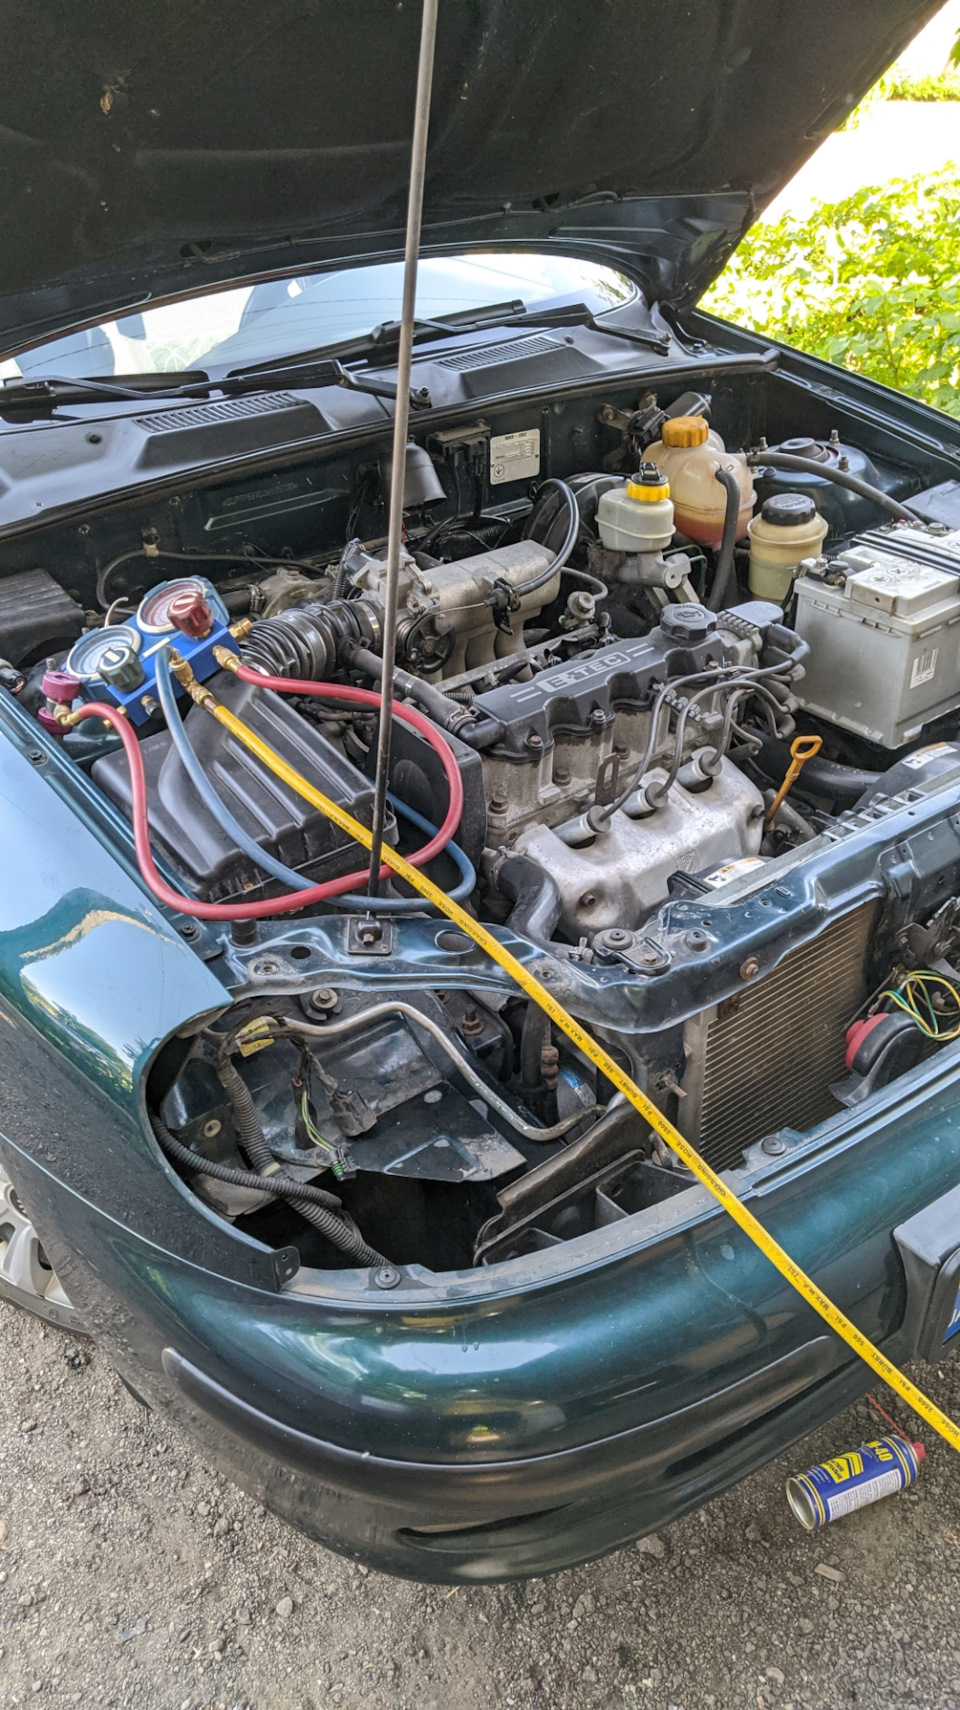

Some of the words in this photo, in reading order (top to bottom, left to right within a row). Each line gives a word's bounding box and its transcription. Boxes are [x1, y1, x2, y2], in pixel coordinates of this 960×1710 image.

[458, 918, 487, 945] CHARGING
[587, 1046, 598, 1057] PSI
[618, 1078, 637, 1098] BURST
[642, 1103, 652, 1114] PSI
[657, 1120, 671, 1135] 2500
[675, 1141, 691, 1158] HOSE
[696, 1164, 726, 1196] CHARGING
[834, 1316, 847, 1328] PSI
[852, 1333, 864, 1345] 500
[870, 1352, 892, 1373] BURST
[898, 1379, 910, 1391] PSI
